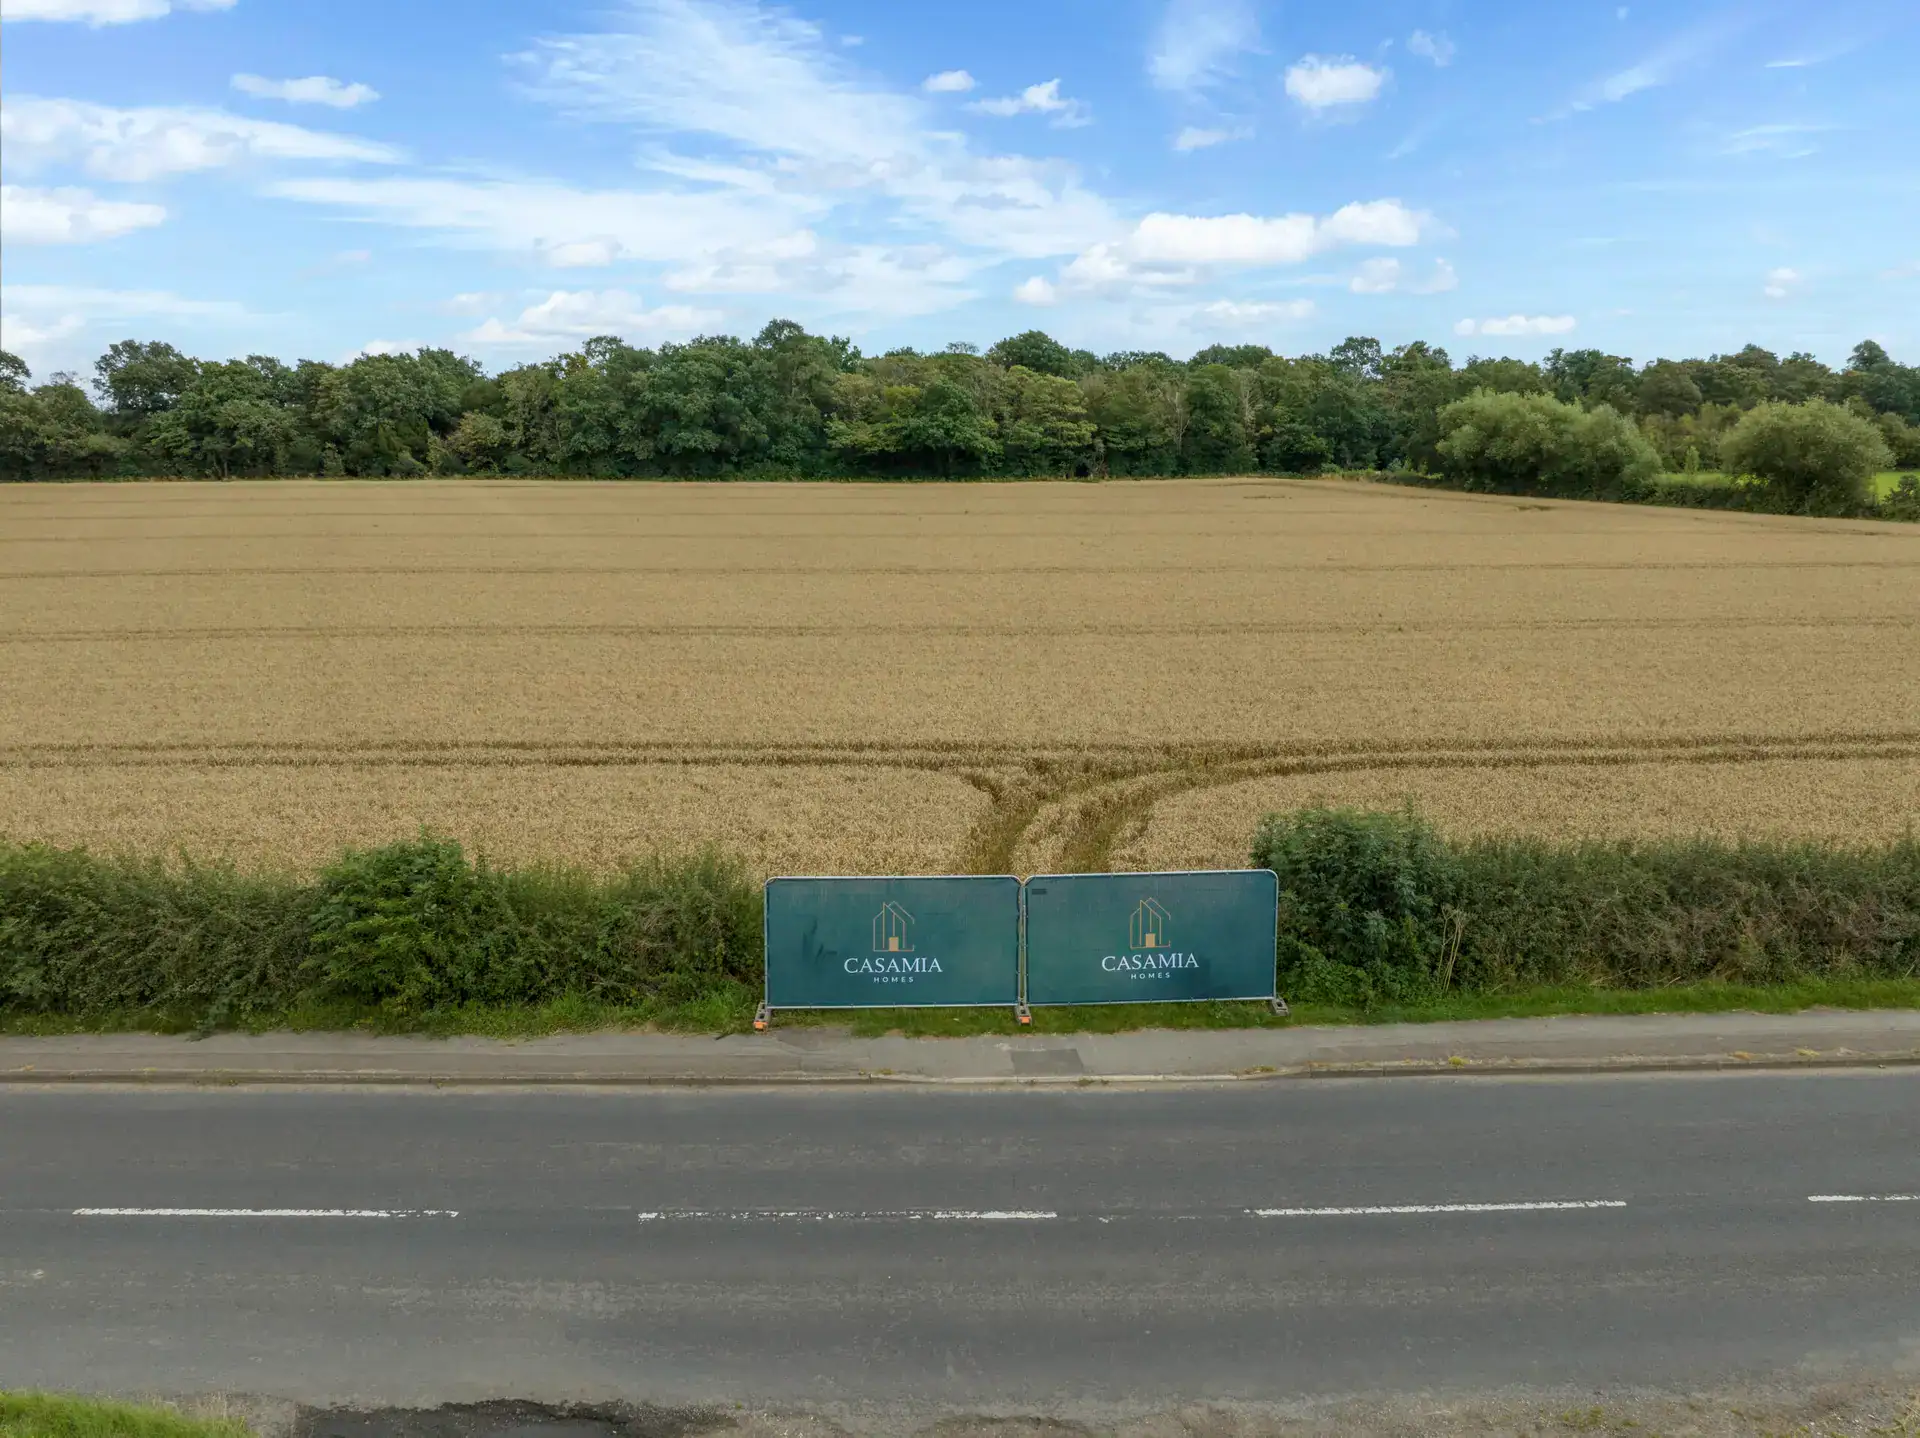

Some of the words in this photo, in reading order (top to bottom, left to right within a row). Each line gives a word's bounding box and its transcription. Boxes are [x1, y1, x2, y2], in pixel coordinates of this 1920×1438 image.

[843, 957, 943, 974] CASAMIA
[1101, 952, 1199, 972] CASAMIA
[1130, 972, 1171, 980] HOMES
